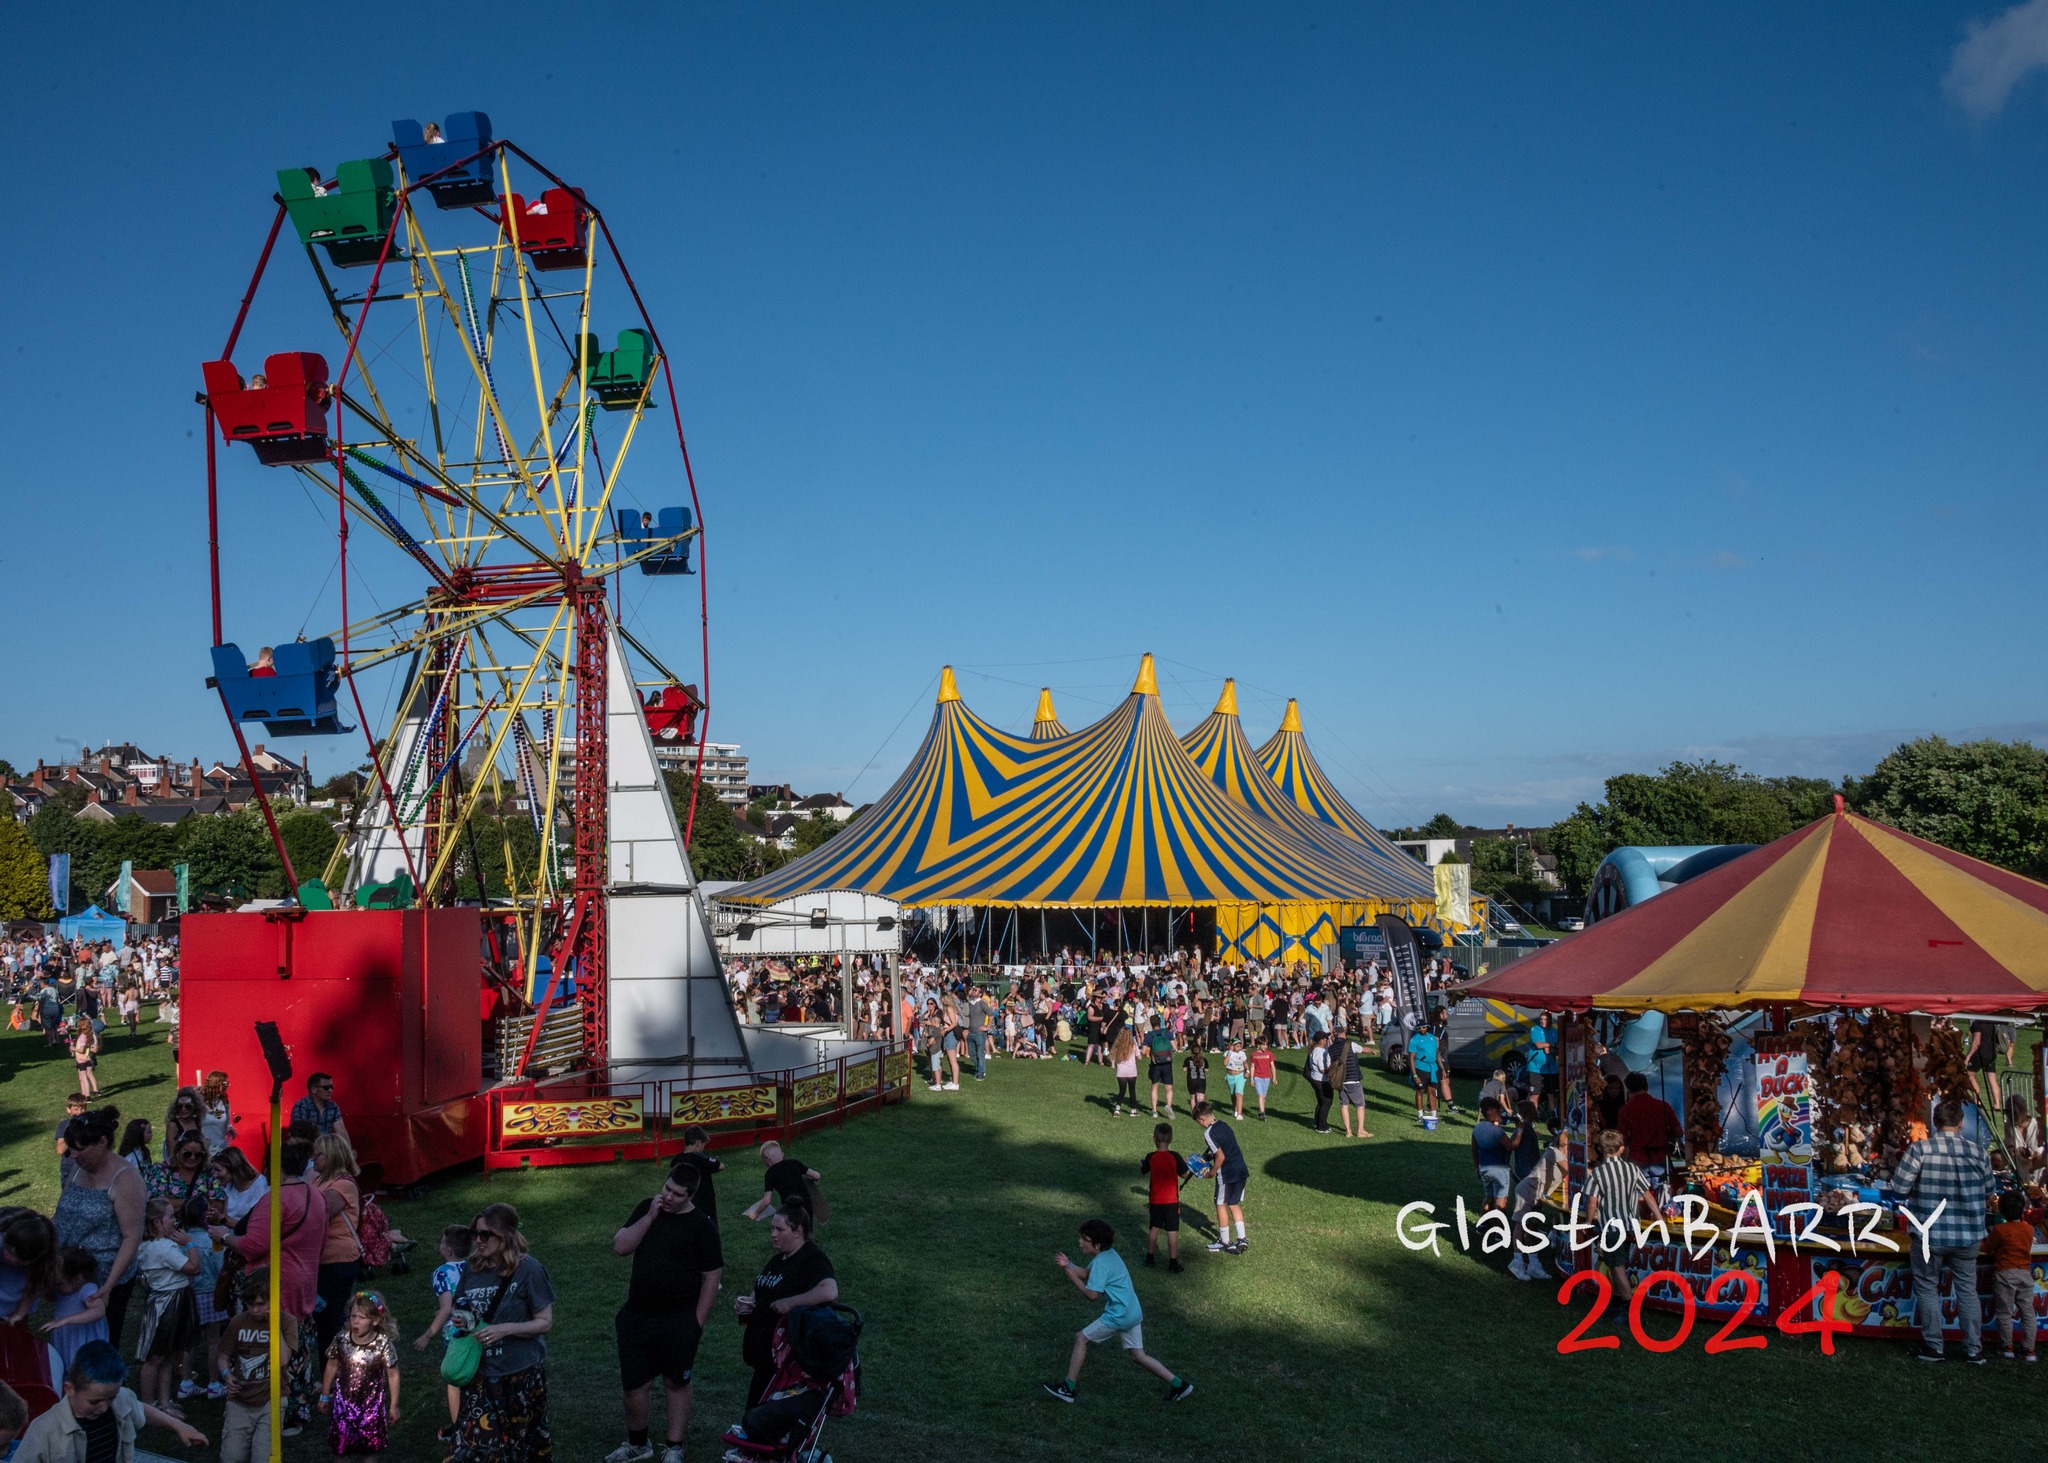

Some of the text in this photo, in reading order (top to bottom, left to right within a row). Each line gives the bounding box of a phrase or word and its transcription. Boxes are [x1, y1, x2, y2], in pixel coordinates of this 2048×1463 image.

[1757, 1035, 1803, 1064] HOOK
[1775, 1057, 1788, 1076] A
[1761, 1073, 1804, 1098] DUCK
[1767, 1165, 1807, 1188] PRIZE
[1626, 1245, 1713, 1274] ATCH ME
[1861, 1268, 1953, 1302] CATH
[237, 1328, 271, 1343] NAS
